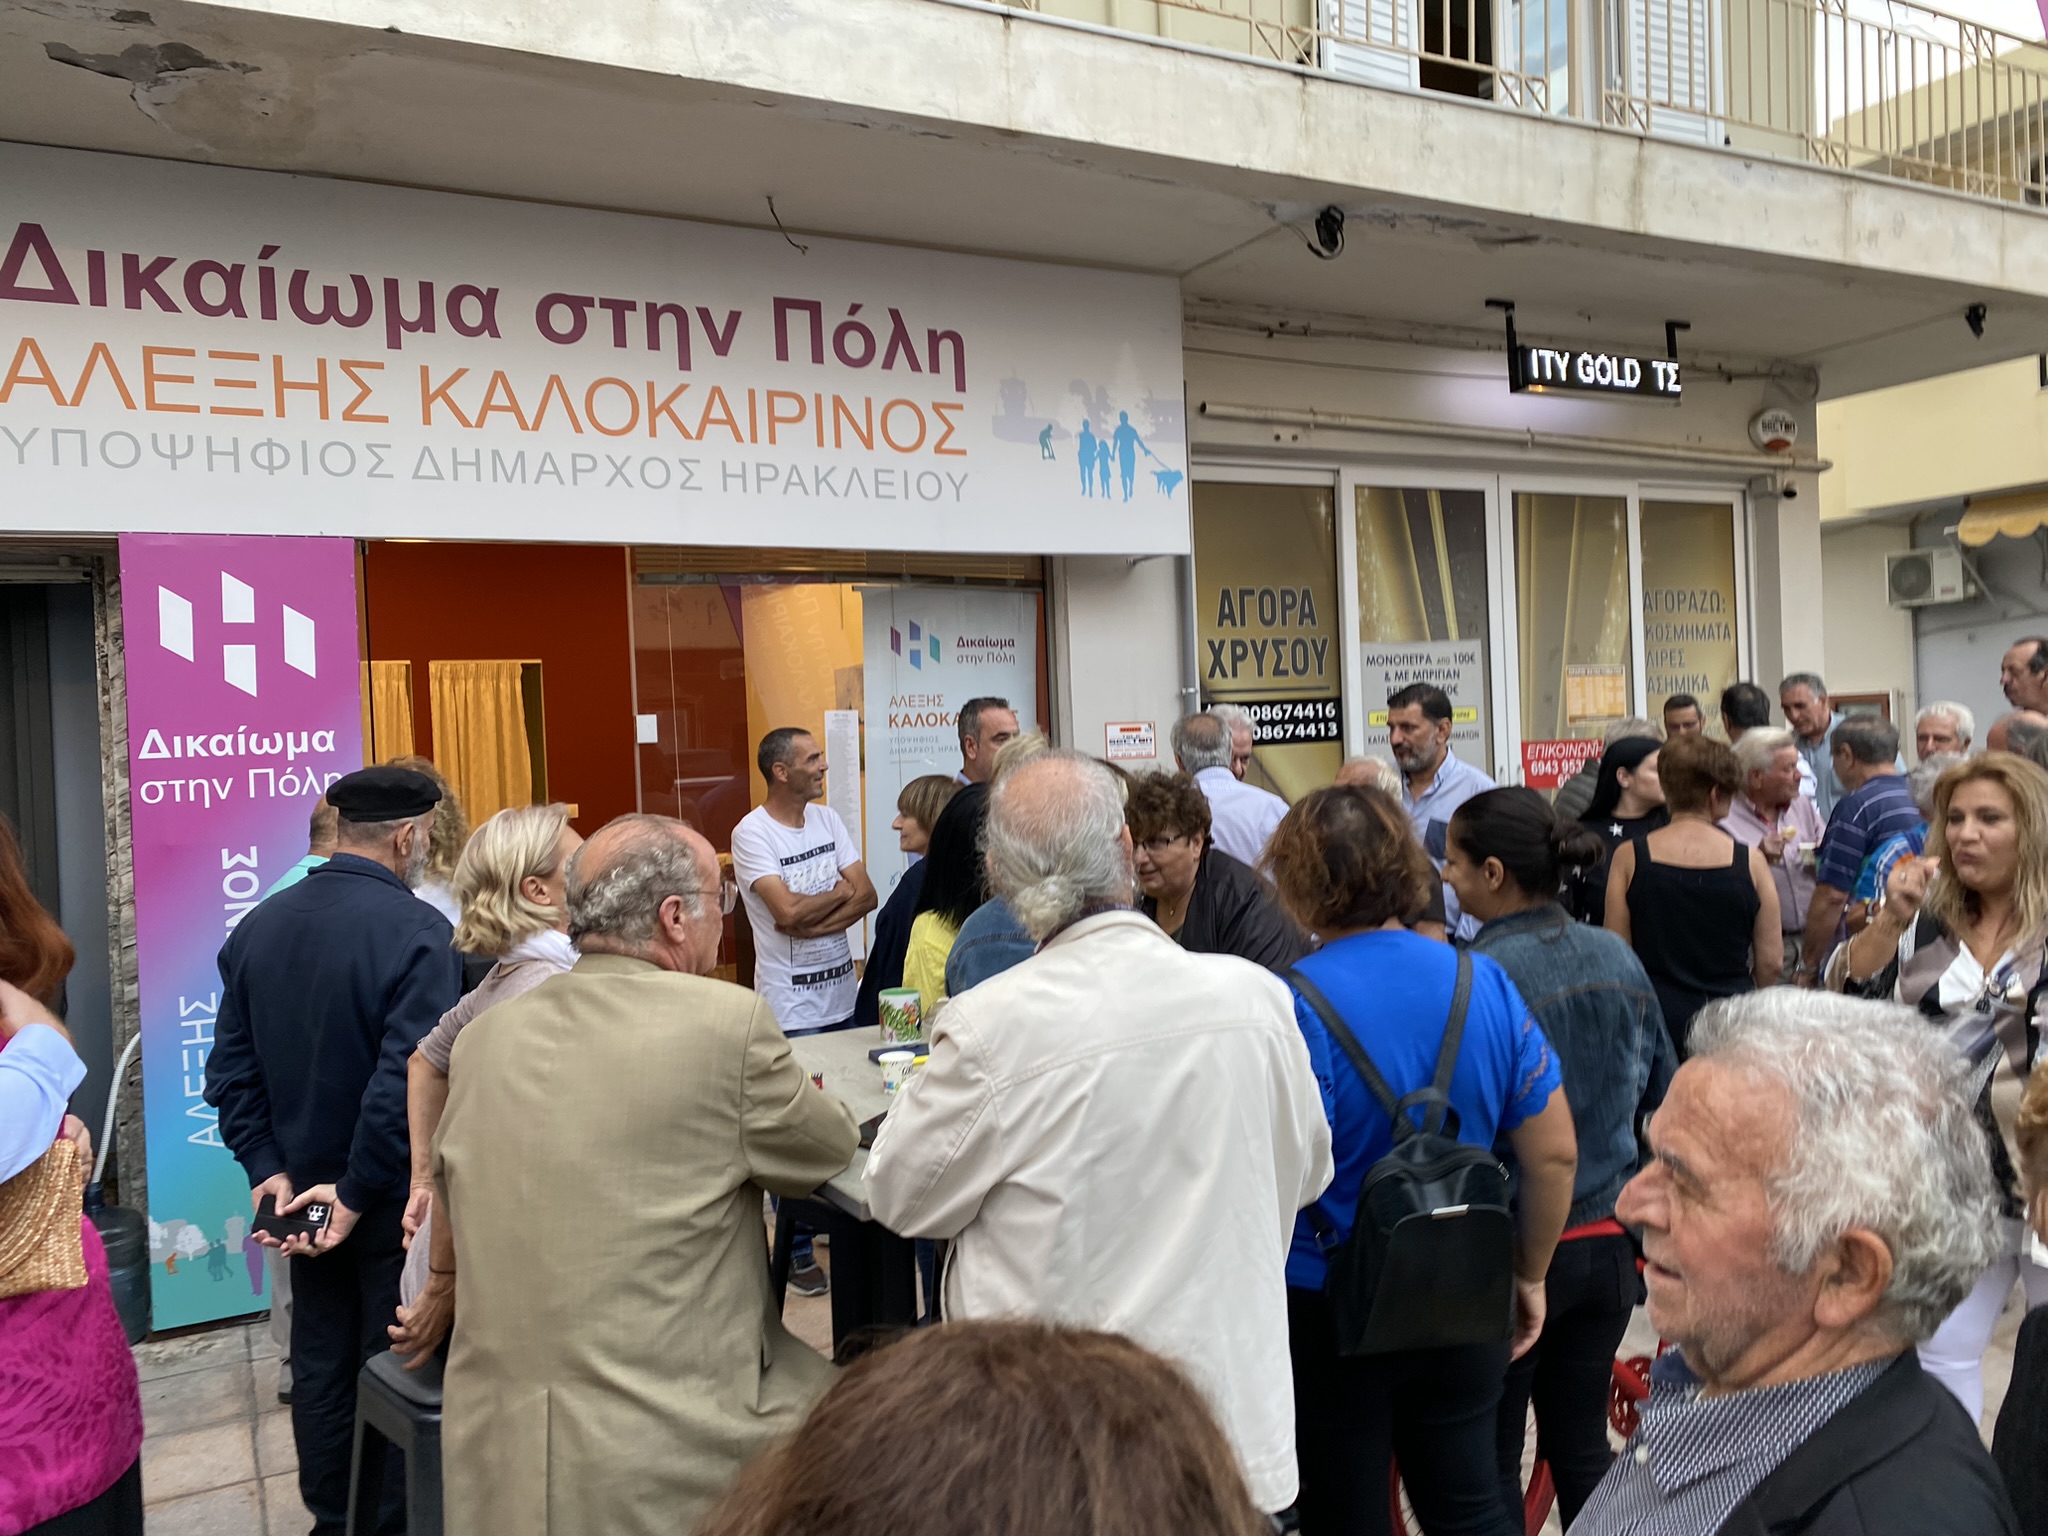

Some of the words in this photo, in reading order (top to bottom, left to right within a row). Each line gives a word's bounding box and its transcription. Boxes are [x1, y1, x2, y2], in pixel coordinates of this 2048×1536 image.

[0, 222, 501, 350] Δικαίωμα
[535, 292, 742, 372] στην
[772, 296, 967, 393] Πόλη
[1530, 348, 1570, 382] ITY
[1577, 352, 1642, 388] GOLD
[0, 337, 390, 424] ΑΛΕΞΗΣ
[419, 364, 968, 457] ΚΑΛΟΚΑΙΡΙΝΟΣ
[0, 425, 395, 480] ΥΠΟΨΗΦΙΟΣ
[411, 446, 704, 492] ΔΗΜΑΡΧΟΣ
[721, 459, 970, 504] ΗΡΑΚΛΕΙΟΥ
[1216, 587, 1319, 629] ΑΓΟΡΑ
[1643, 589, 1726, 614] ΑΓΟΡΑΖΩ:
[956, 634, 1016, 651] Δικαίωμα
[1645, 621, 1732, 643] ΚΟΣΜΗΜΑΤΑ
[956, 652, 983, 667] στην
[986, 650, 1016, 666] Πόλη
[1207, 637, 1329, 680] ΧΡΥΣΟΥ
[1366, 653, 1433, 668] ΜΟΝΟΠΕΤΡΑ
[1453, 651, 1476, 665] 100€
[1394, 669, 1409, 682] ΜΕ
[1647, 673, 1710, 695] ΑΣΗΜΙΚΑ
[889, 693, 944, 709] ΑΛΕΞΗΣ
[137, 724, 336, 762] Δικαίωμα
[1531, 759, 1559, 776] 6943
[139, 776, 234, 809] στην
